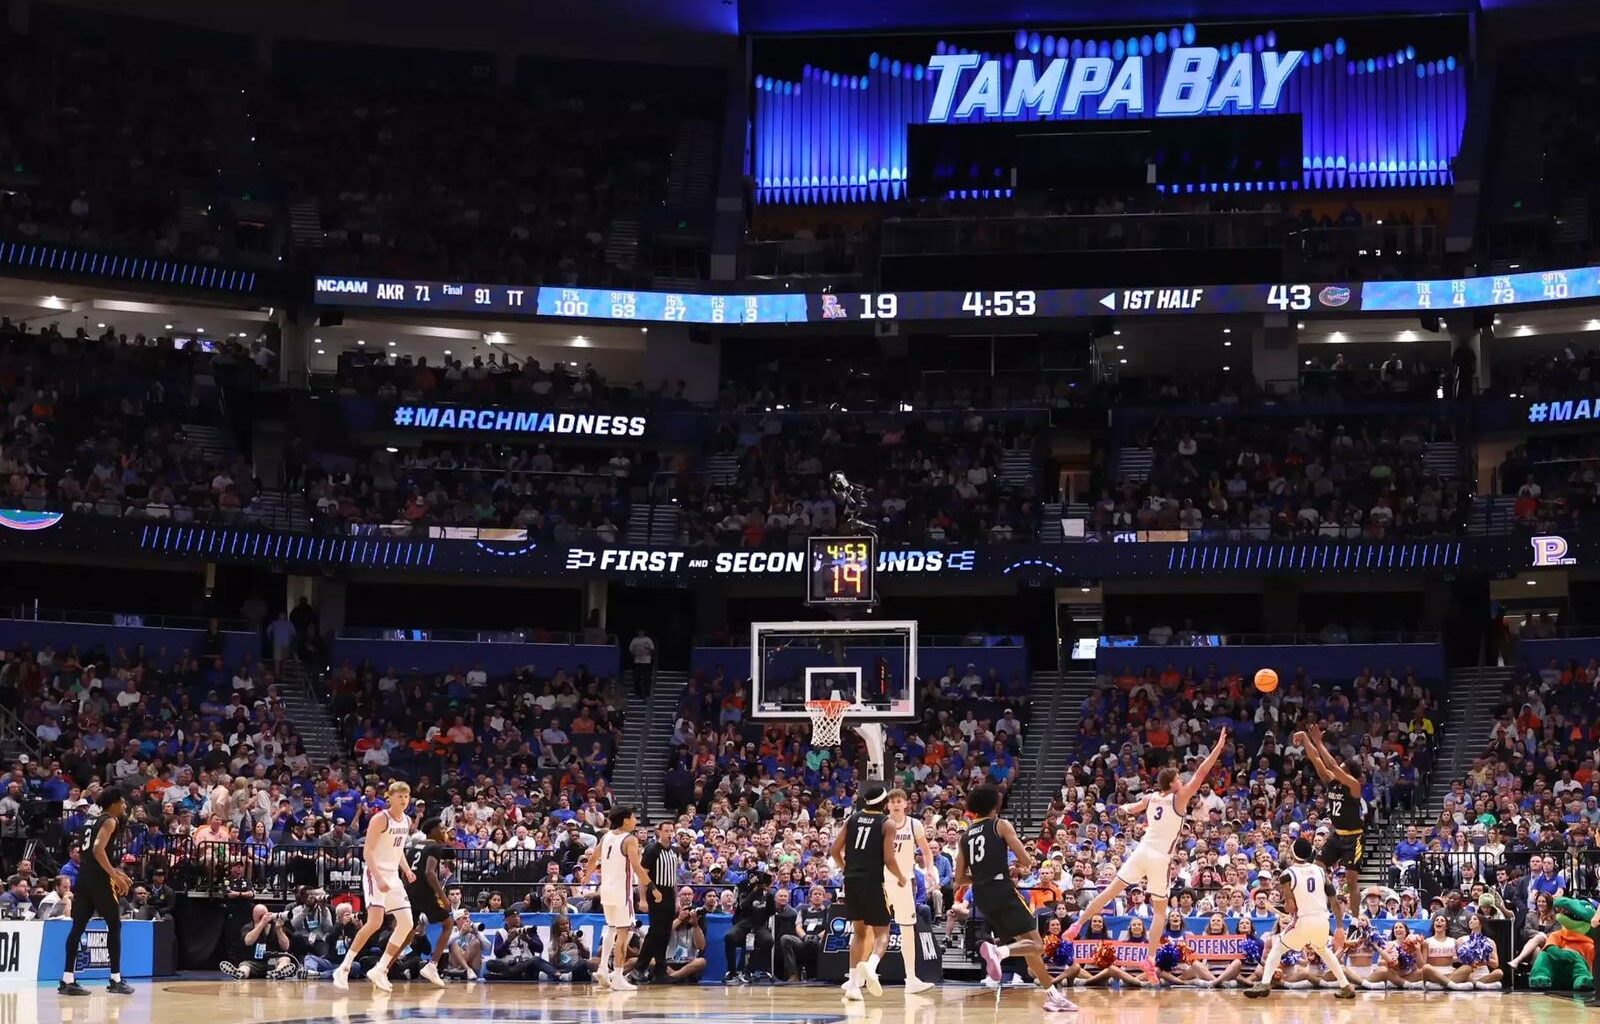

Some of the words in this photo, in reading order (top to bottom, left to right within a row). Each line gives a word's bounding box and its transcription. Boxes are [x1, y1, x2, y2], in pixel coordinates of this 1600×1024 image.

[928, 54, 1144, 123] TAMPA
[1156, 46, 1304, 116] BAY
[316, 279, 368, 293] NCAAM
[376, 283, 405, 300] AKR
[415, 285, 430, 301] 71
[442, 284, 463, 296] Final
[1544, 284, 1567, 299] 40
[474, 288, 491, 304] 91
[506, 290, 523, 306] TT
[962, 291, 1036, 317] 4:53
[1122, 290, 1154, 310] 1ST
[1156, 289, 1203, 310] HALF
[1267, 285, 1311, 311] 43
[1418, 294, 1431, 309] 4
[1453, 292, 1465, 307] 4
[1492, 288, 1514, 304] 73
[555, 300, 589, 316] 100
[611, 304, 636, 318] 63
[664, 307, 686, 320] 27
[860, 293, 897, 319] 19
[712, 309, 724, 322] 6
[746, 309, 758, 322] 3
[394, 406, 646, 436] #MARCHMADNESS
[826, 543, 867, 561] 4:53
[600, 550, 684, 572] FIRST
[689, 560, 708, 568] AND
[714, 552, 805, 573] SECON
[831, 563, 861, 593] 19
[1154, 806, 1163, 821] 3
[1332, 801, 1342, 816] 12
[82, 828, 92, 851] 3
[855, 826, 871, 849] 11
[607, 846, 612, 859] 1
[968, 835, 986, 865] 13
[411, 851, 421, 871] 2
[1307, 877, 1316, 893] 0
[1189, 939, 1244, 954] DEFENSE
